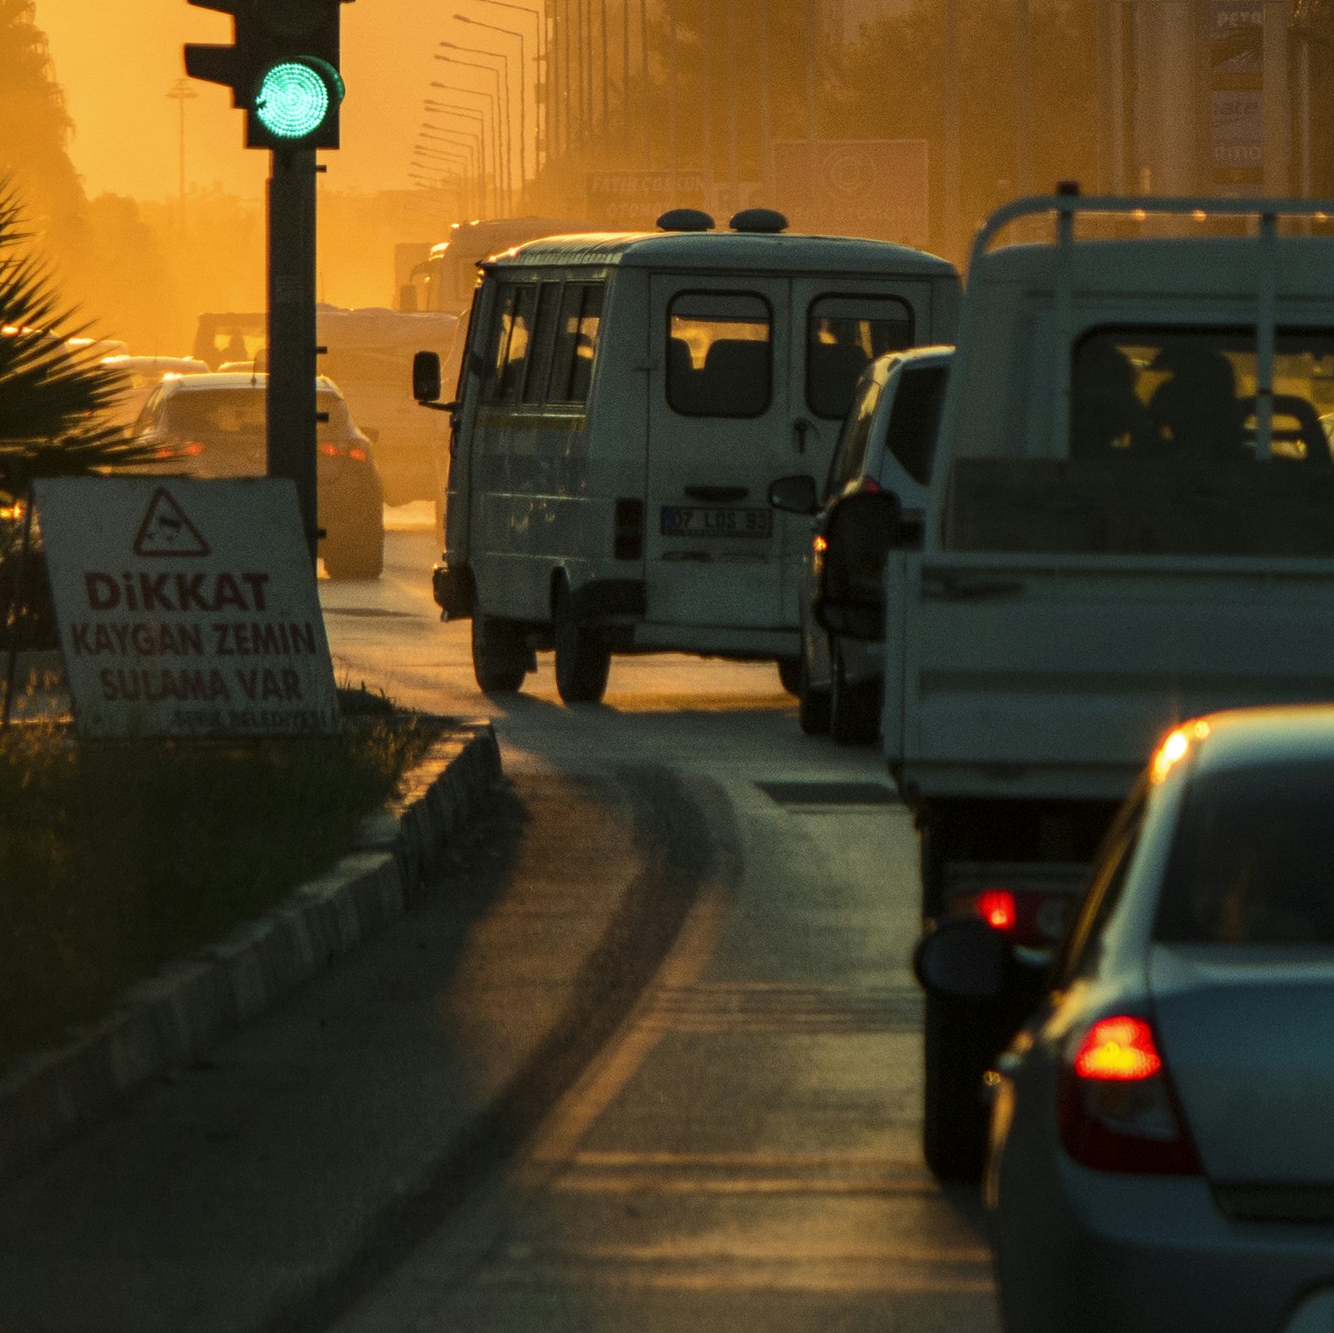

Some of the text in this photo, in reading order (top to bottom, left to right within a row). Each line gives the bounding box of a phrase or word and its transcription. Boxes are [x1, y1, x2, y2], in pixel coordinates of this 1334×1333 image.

[71, 621, 205, 656] KAYGAN
[99, 668, 303, 704] SULAMA VAR
